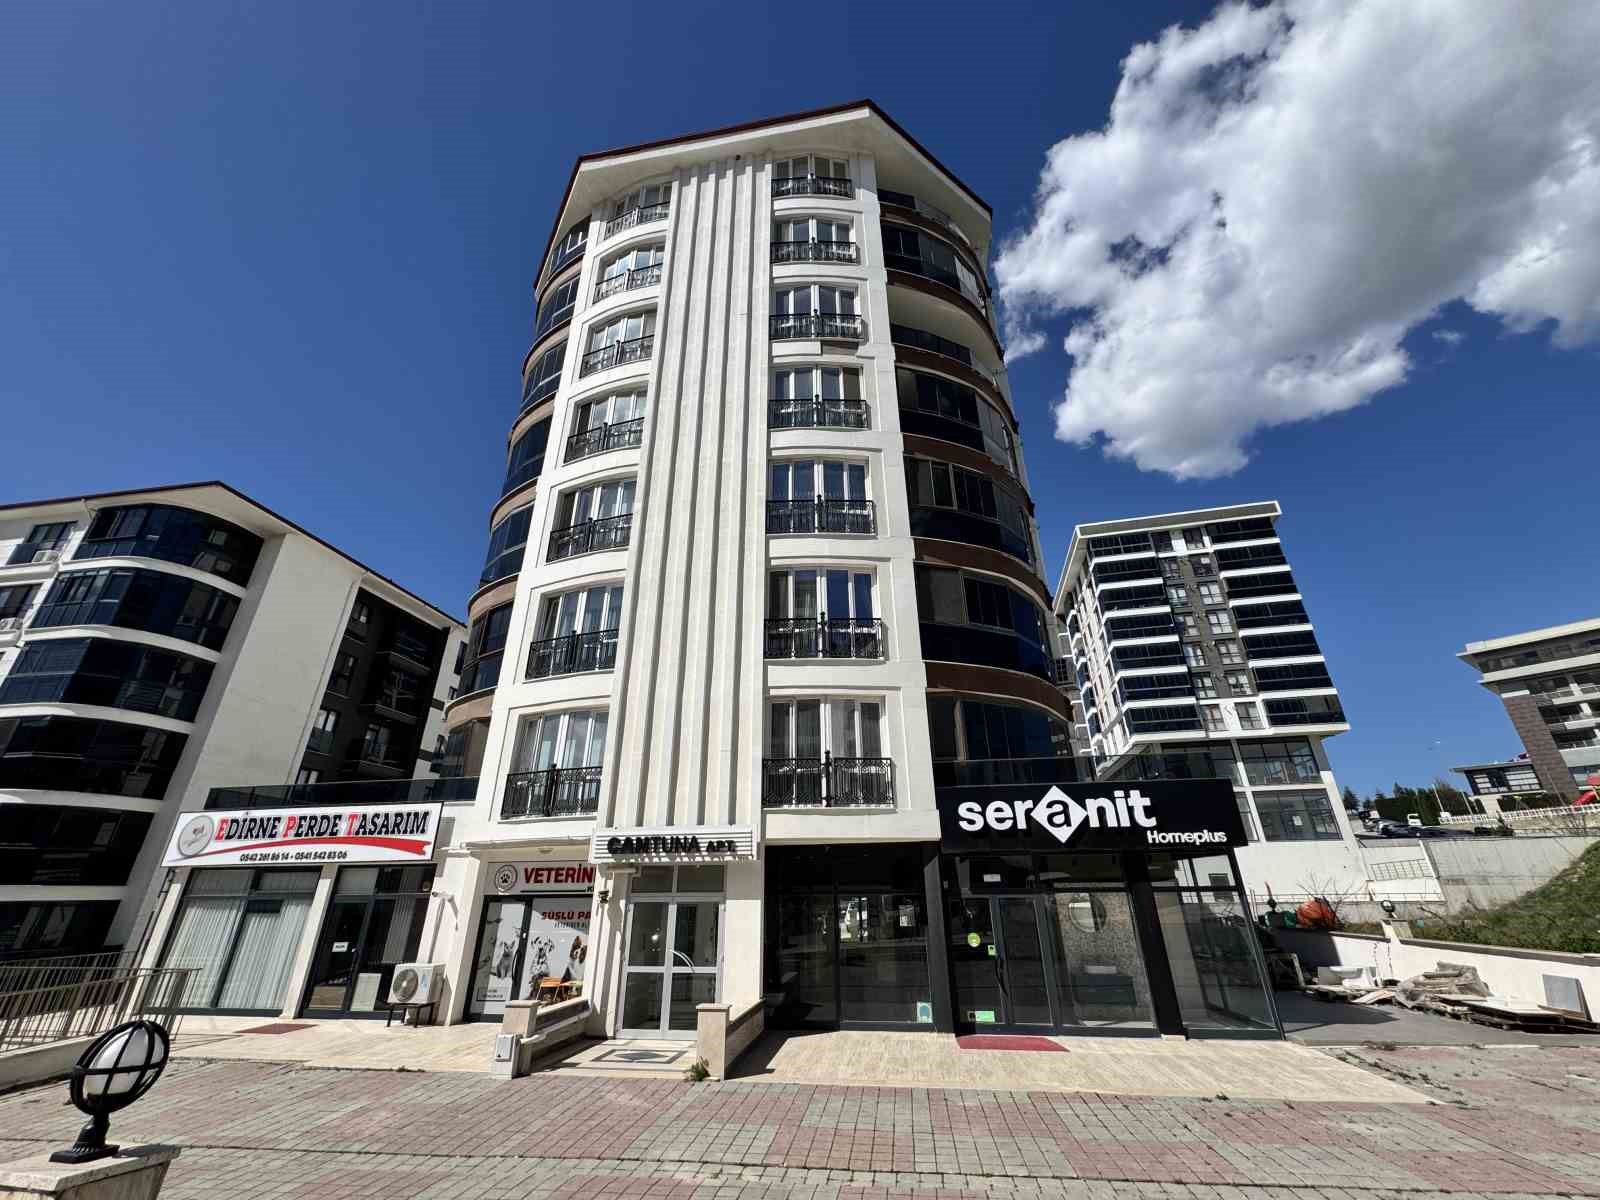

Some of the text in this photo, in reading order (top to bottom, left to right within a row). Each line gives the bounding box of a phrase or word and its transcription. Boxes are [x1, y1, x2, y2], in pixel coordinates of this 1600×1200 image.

[282, 815, 342, 838] PERDE
[347, 811, 430, 836] TASARIM
[957, 788, 1157, 834] seranit
[1147, 829, 1228, 846] Homeplus
